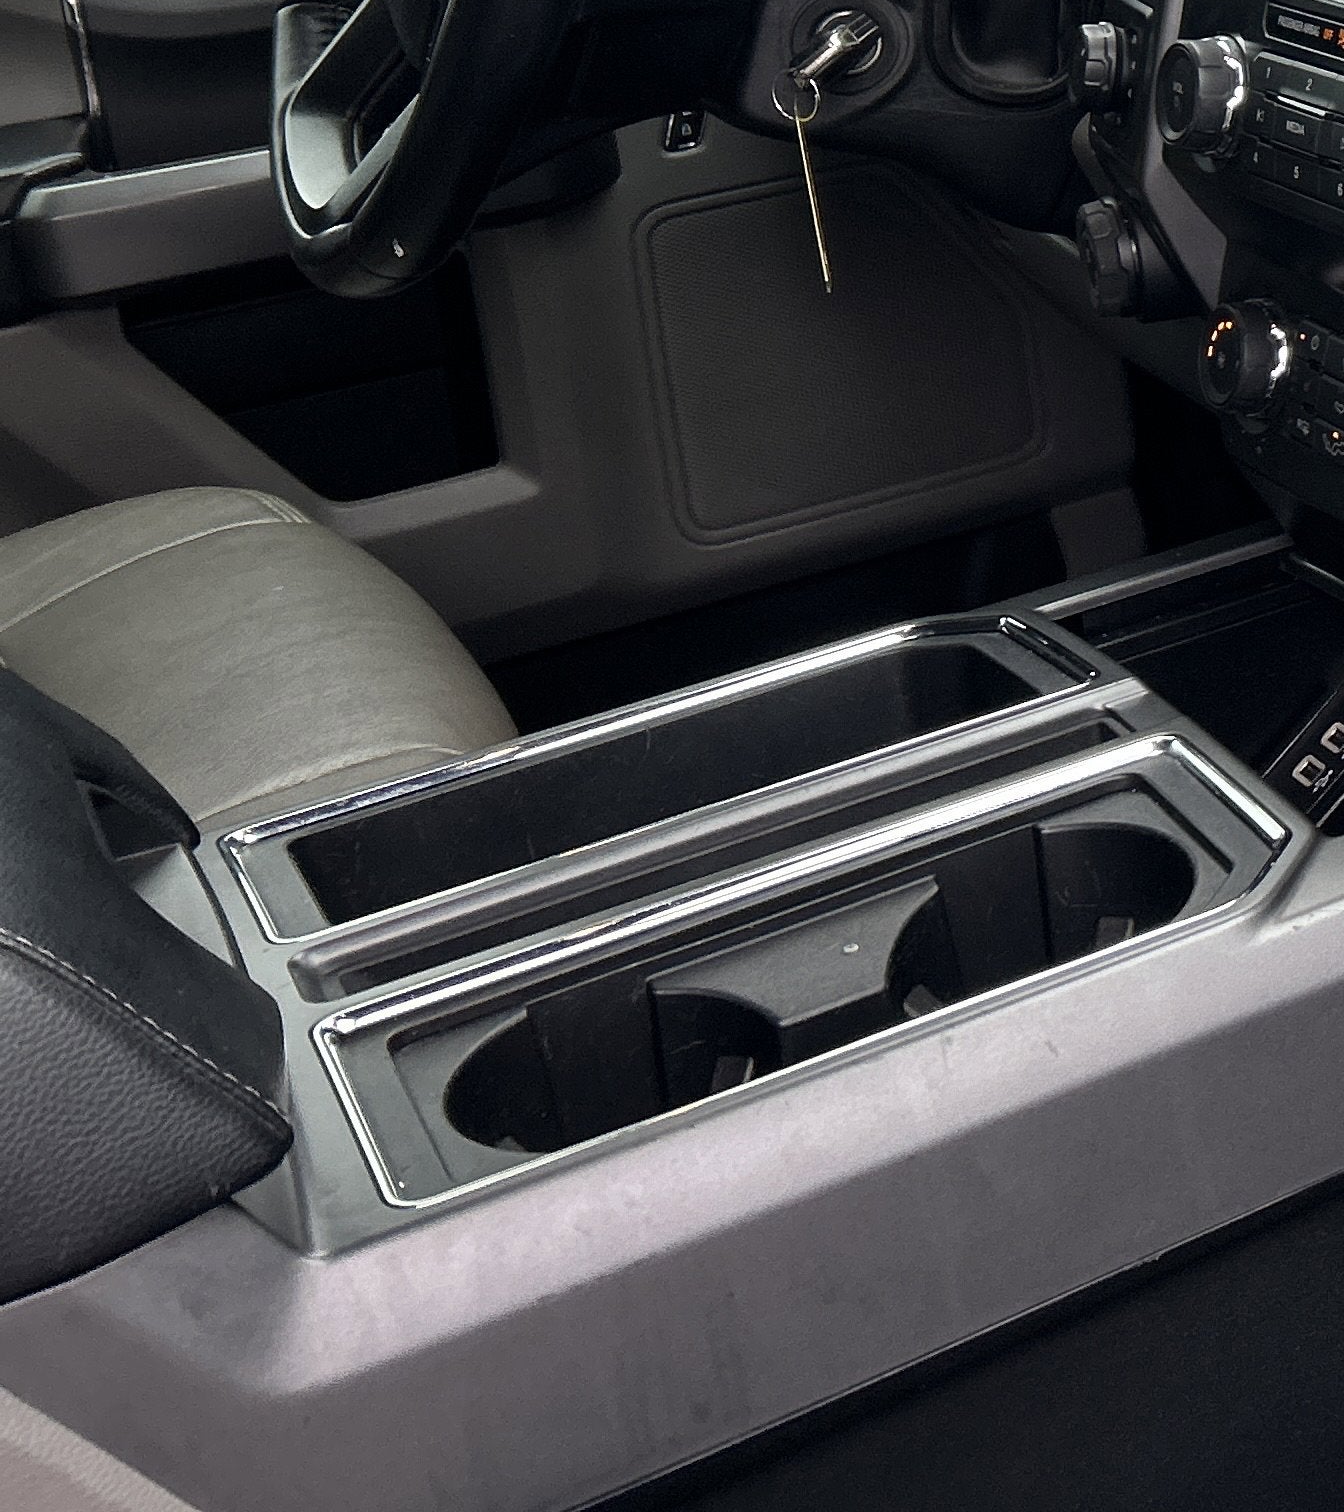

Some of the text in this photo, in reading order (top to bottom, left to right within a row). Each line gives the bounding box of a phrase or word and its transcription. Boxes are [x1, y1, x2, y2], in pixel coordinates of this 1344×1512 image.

[1305, 77, 1314, 92] 2
[1292, 164, 1300, 179] 5
[1336, 182, 1344, 196] 6
